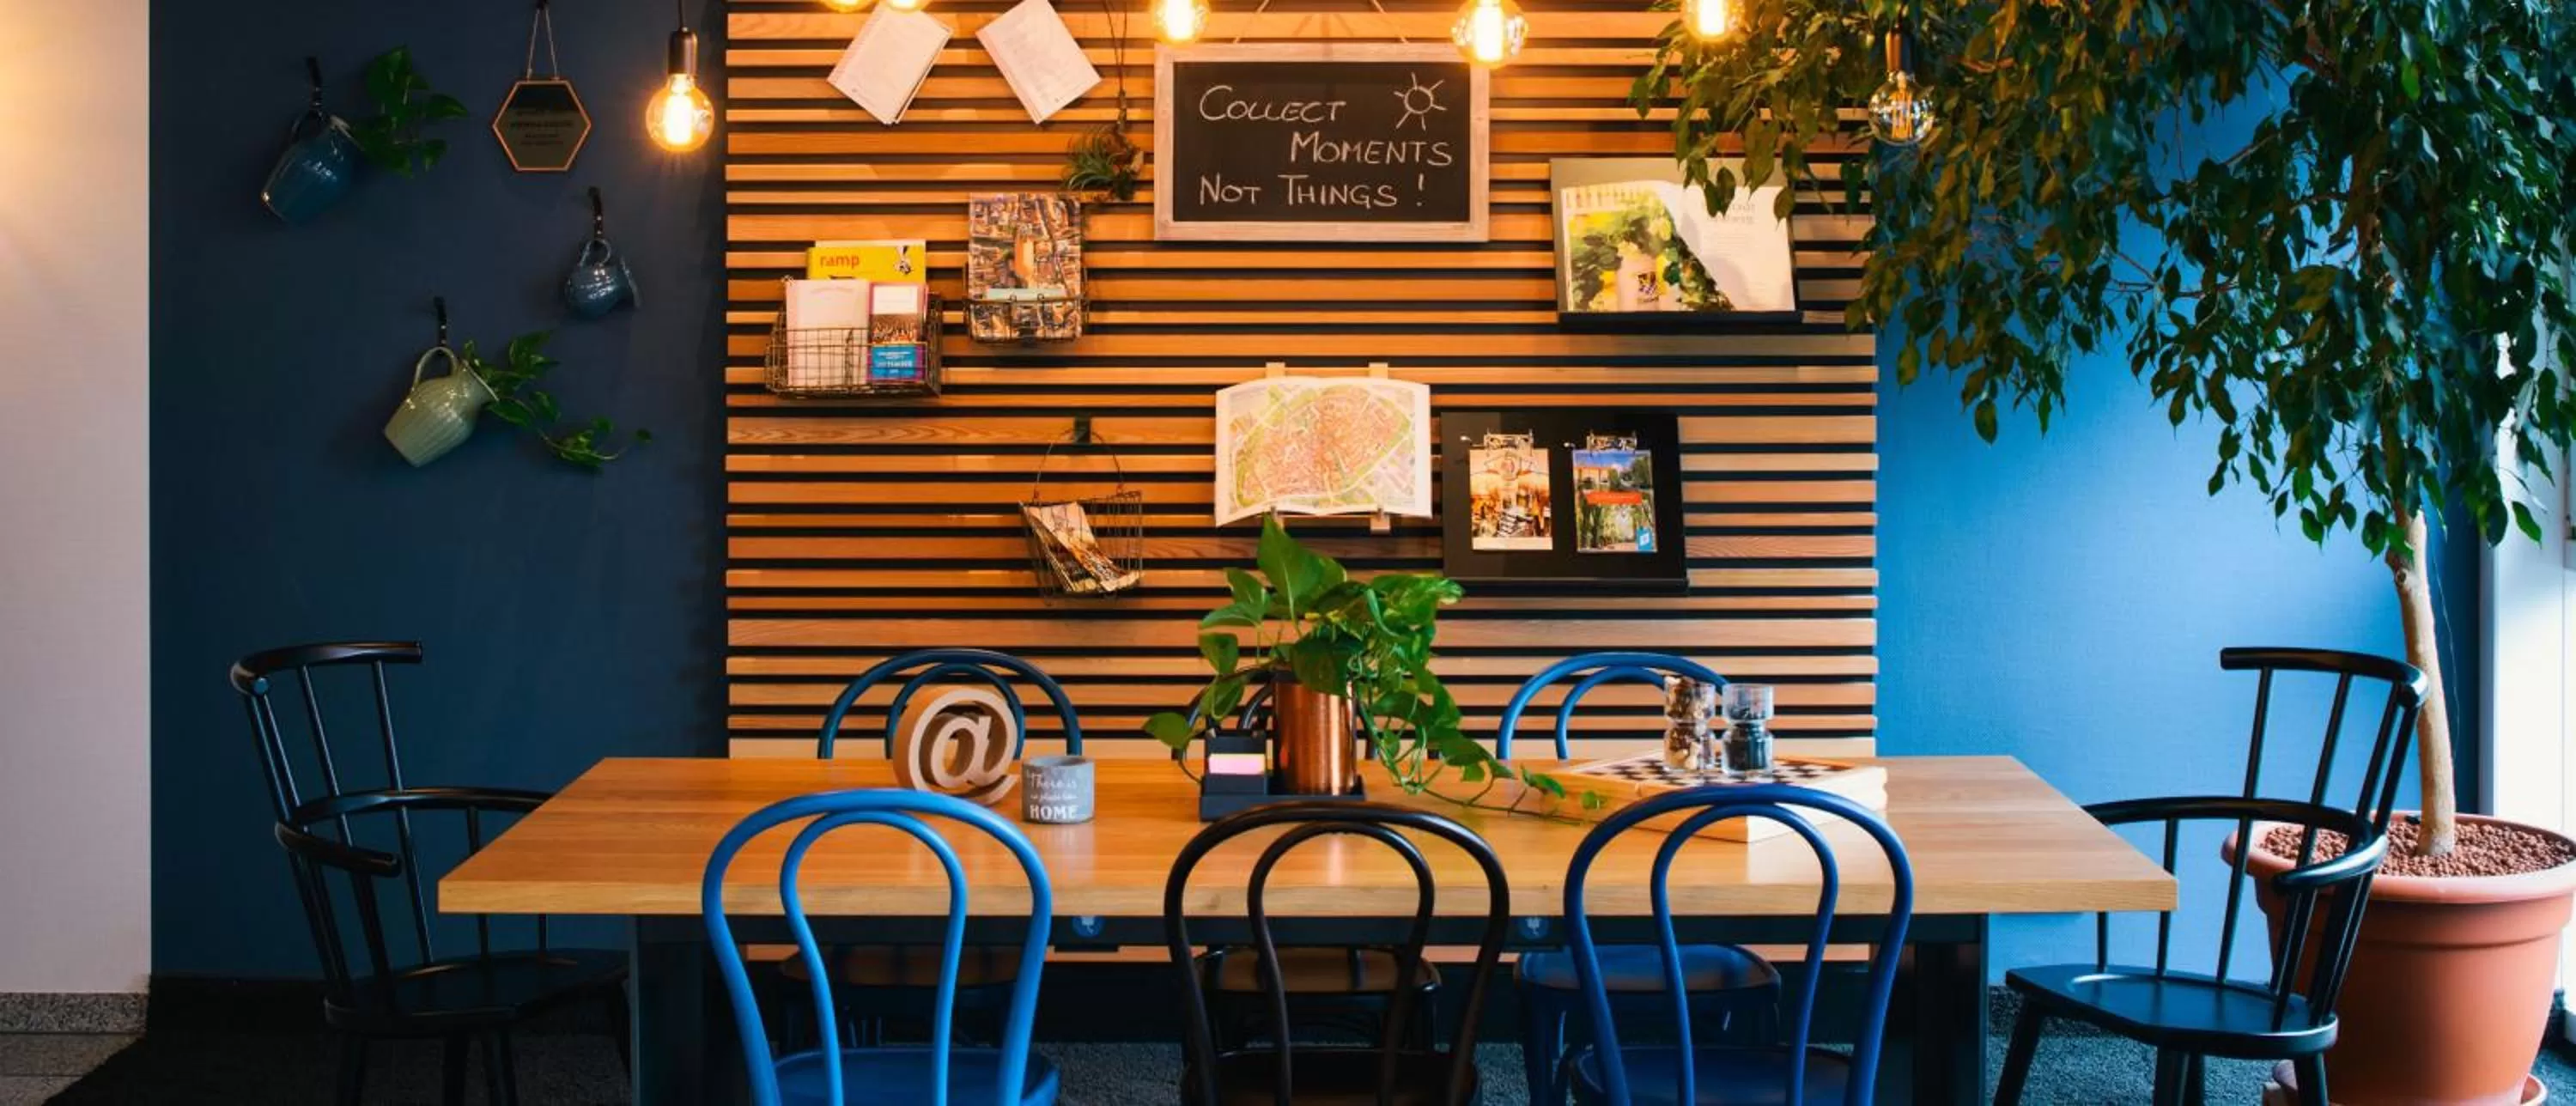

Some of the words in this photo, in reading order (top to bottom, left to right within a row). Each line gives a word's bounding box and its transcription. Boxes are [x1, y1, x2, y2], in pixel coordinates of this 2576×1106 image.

[1199, 85, 1346, 123] COLLECT
[820, 255, 860, 270] ramp
[1030, 804, 1079, 821] HOME
